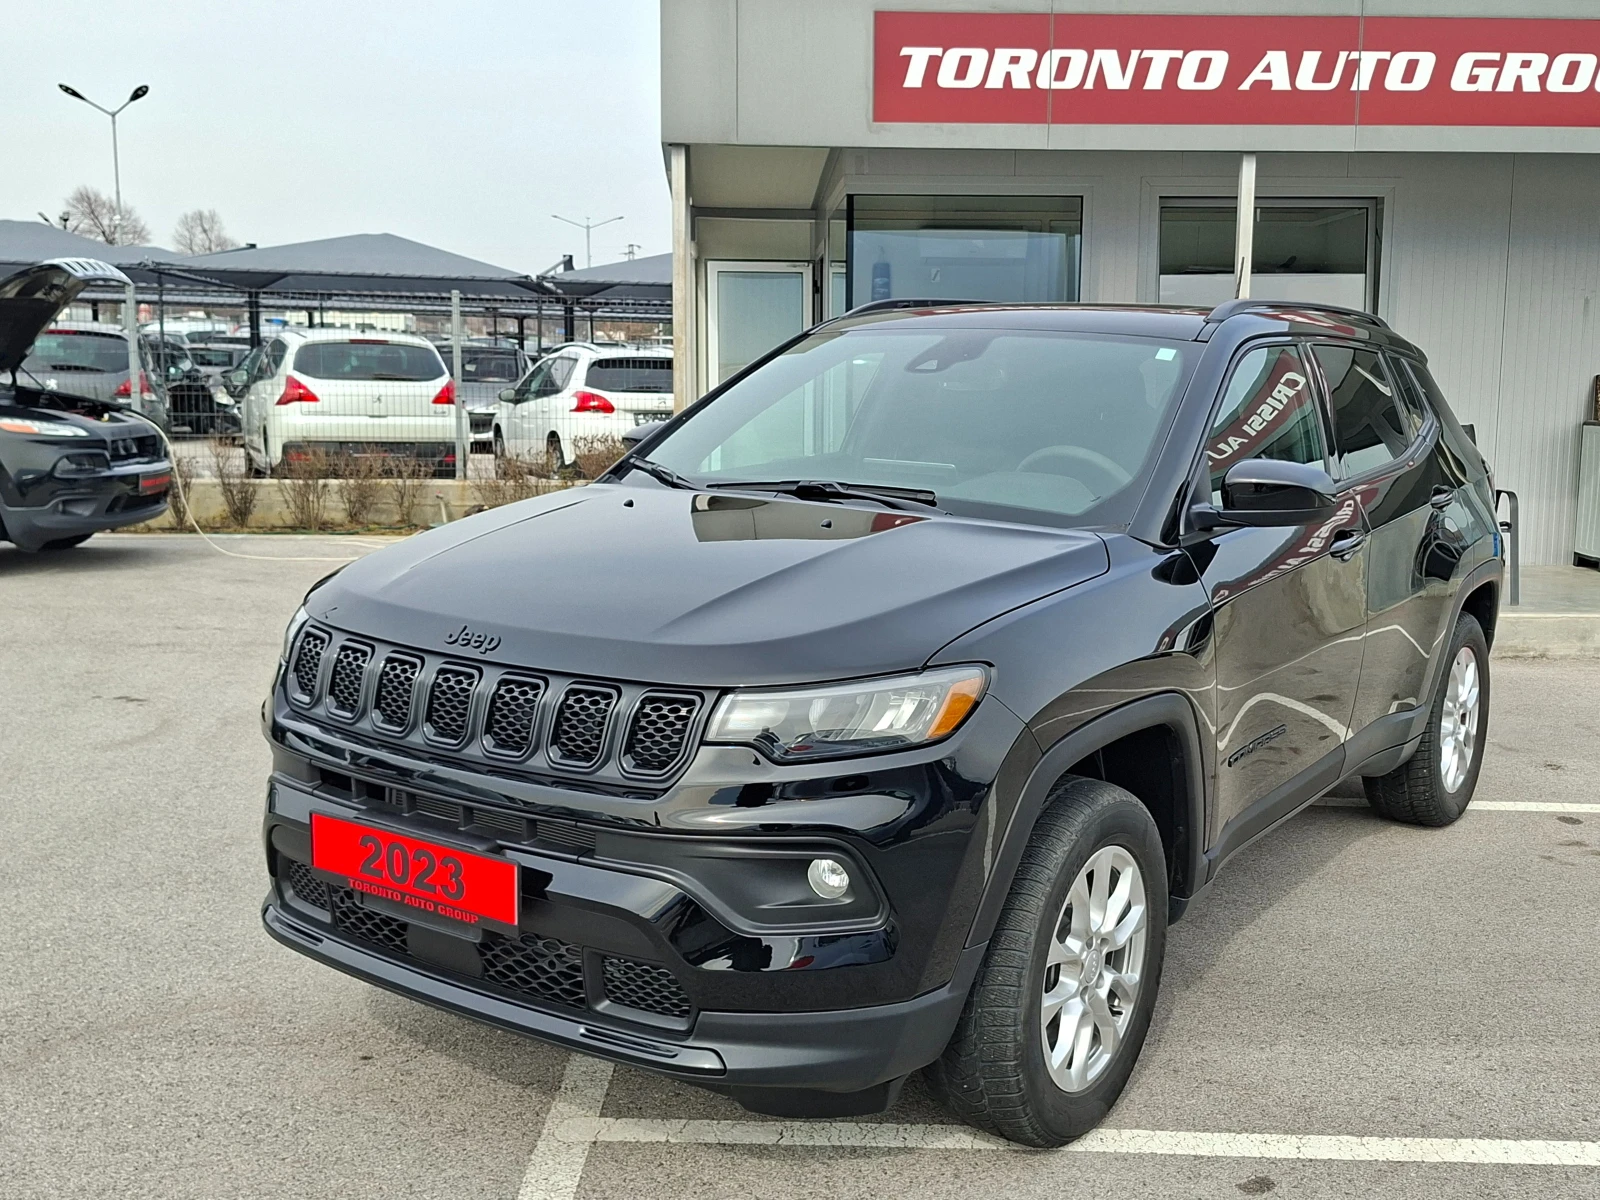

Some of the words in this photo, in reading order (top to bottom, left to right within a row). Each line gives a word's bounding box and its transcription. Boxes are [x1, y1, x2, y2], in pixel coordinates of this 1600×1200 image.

[900, 47, 1229, 91] TORONTO
[1238, 50, 1437, 91] AUTO
[1450, 51, 1600, 93] GRO
[443, 624, 501, 655] Jeep
[358, 834, 466, 901] 2023
[348, 877, 401, 902] TORONTO
[404, 894, 435, 912] AUTO
[437, 904, 479, 924] GROUP
